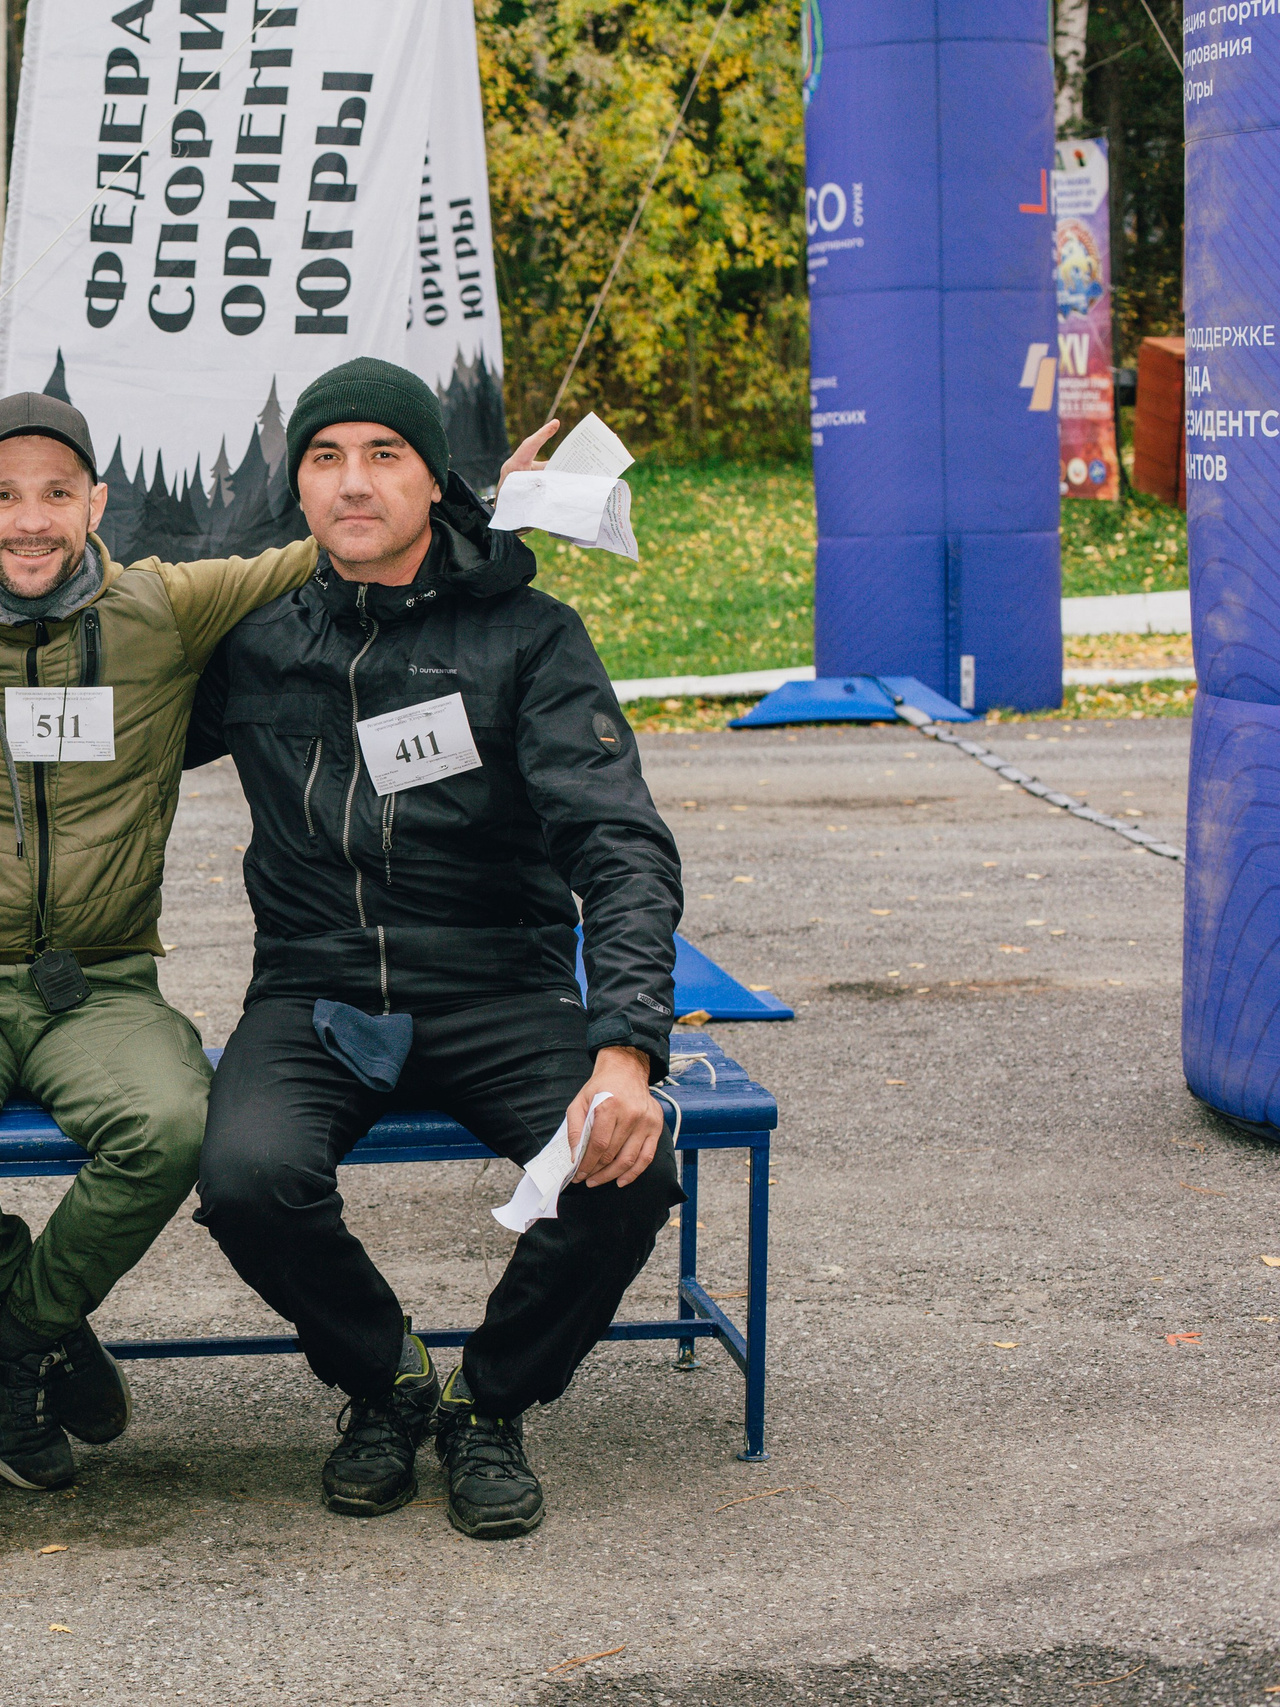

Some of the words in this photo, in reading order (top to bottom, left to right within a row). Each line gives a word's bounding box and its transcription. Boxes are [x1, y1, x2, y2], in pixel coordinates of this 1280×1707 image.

[1209, 0, 1280, 26] спорти
[1183, 36, 1253, 71] тирования
[84, 0, 155, 329] ФЕДЕРА
[148, 0, 227, 333] СПОРТИ
[221, 0, 299, 336] ОРИЕНТ
[294, 72, 374, 335] ЮГРЫ
[449, 197, 485, 322] ЮГРЫ
[1185, 365, 1212, 397] НДА
[419, 667, 458, 675] OUTVENTURE
[36, 714, 81, 738] 511
[395, 730, 443, 763] 411
